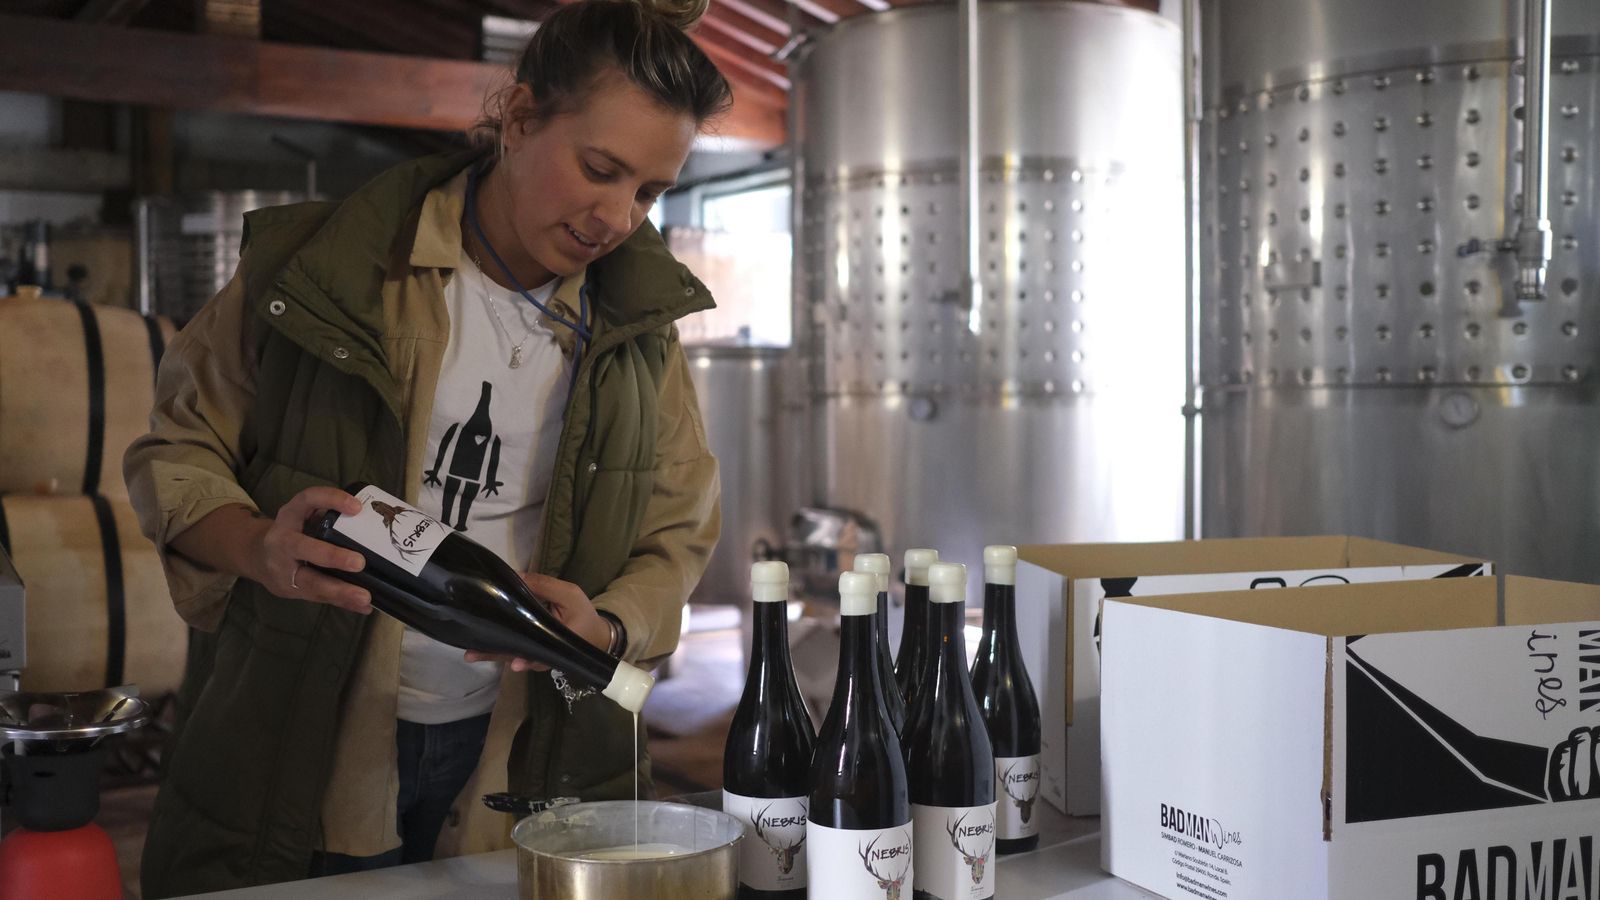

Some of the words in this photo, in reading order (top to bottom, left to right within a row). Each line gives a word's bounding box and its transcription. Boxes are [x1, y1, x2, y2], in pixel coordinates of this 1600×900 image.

[1008, 772, 1039, 784] NEBRIS
[762, 814, 806, 828] NEBRIS
[958, 822, 993, 838] NEBRIS
[1211, 818, 1242, 850] Wines
[871, 844, 909, 862] NEBRIS
[1161, 831, 1177, 844] SIMBAD
[1177, 838, 1196, 850] ROMERO
[1198, 845, 1217, 859] MANUEL
[1217, 852, 1243, 868] CARRIZOSA
[1416, 834, 1600, 900] BADMA
